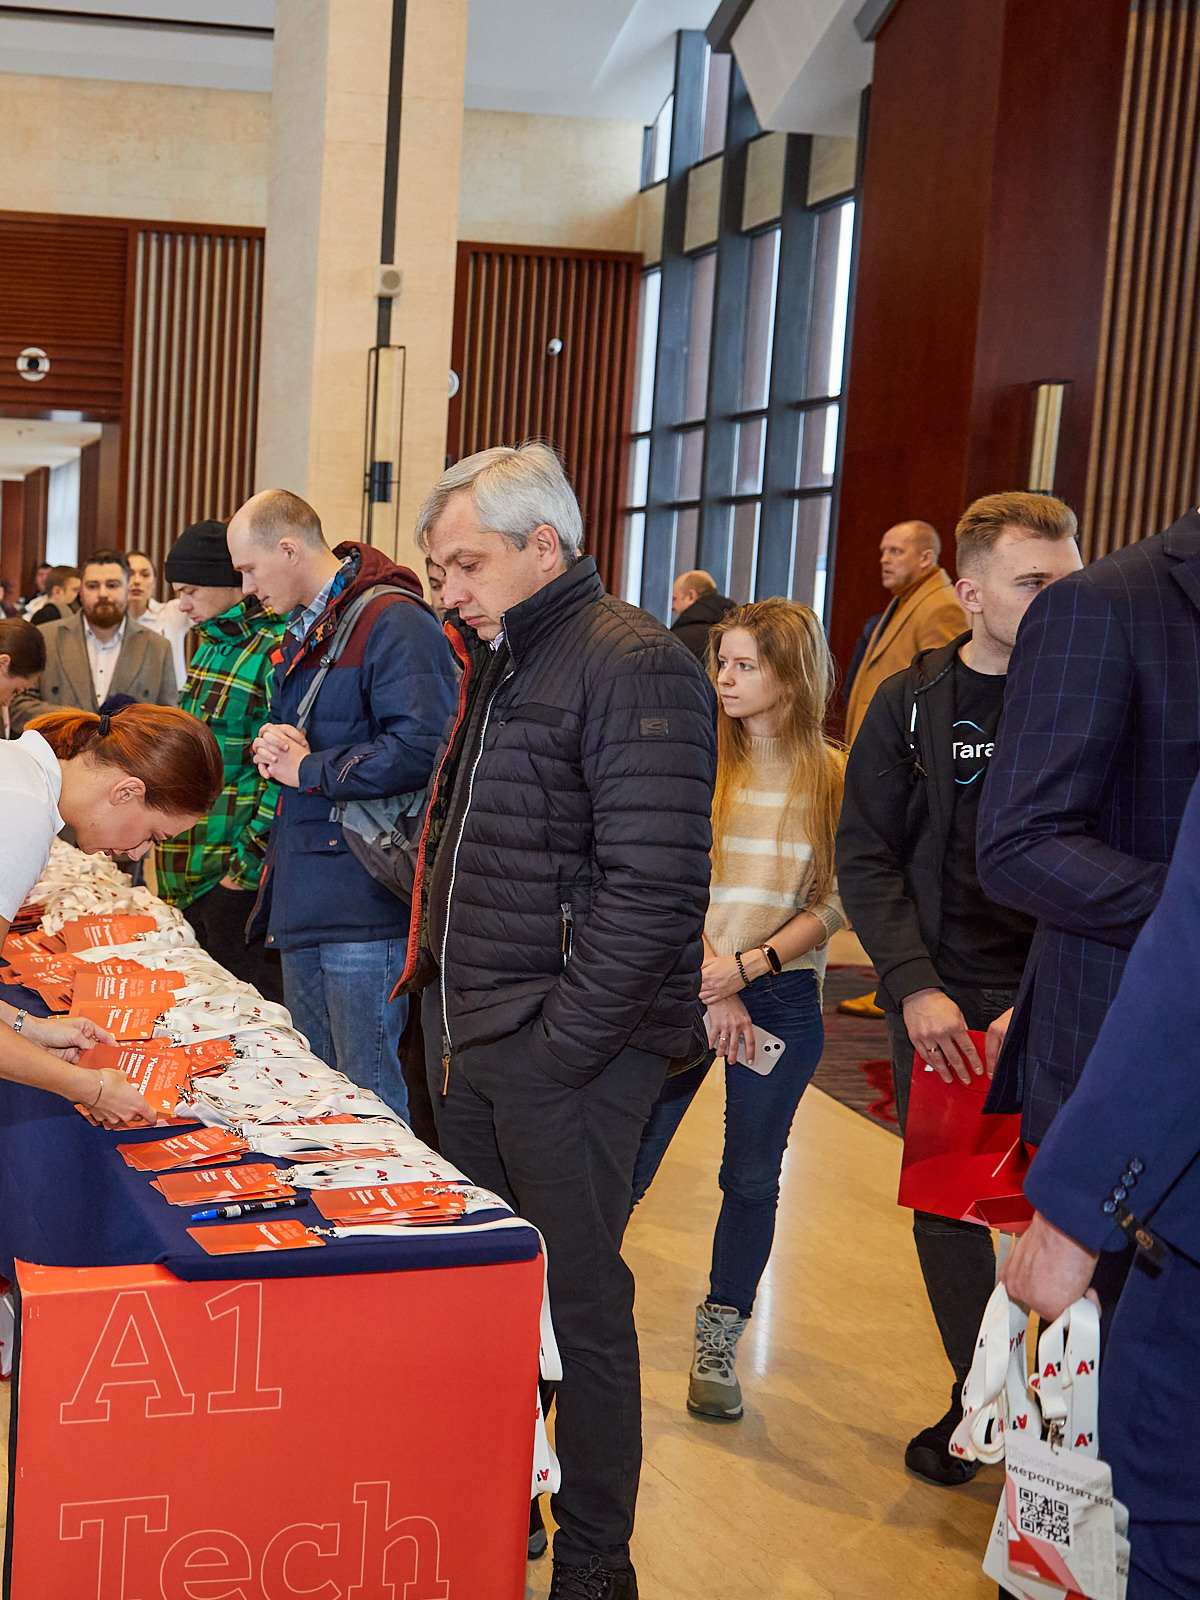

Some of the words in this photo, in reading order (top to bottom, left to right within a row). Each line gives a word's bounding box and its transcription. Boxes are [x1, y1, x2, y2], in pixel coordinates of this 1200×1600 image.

[376, 1169, 389, 1182] A1
[59, 1282, 282, 1425] A1
[1043, 1361, 1061, 1378] A1
[1076, 1360, 1094, 1376] A1
[1012, 1414, 1028, 1430] A1
[1074, 1432, 1092, 1448] A1
[536, 1468, 550, 1482] A1
[1007, 1464, 1114, 1508] мероприятия
[60, 1481, 450, 1600] Tech
